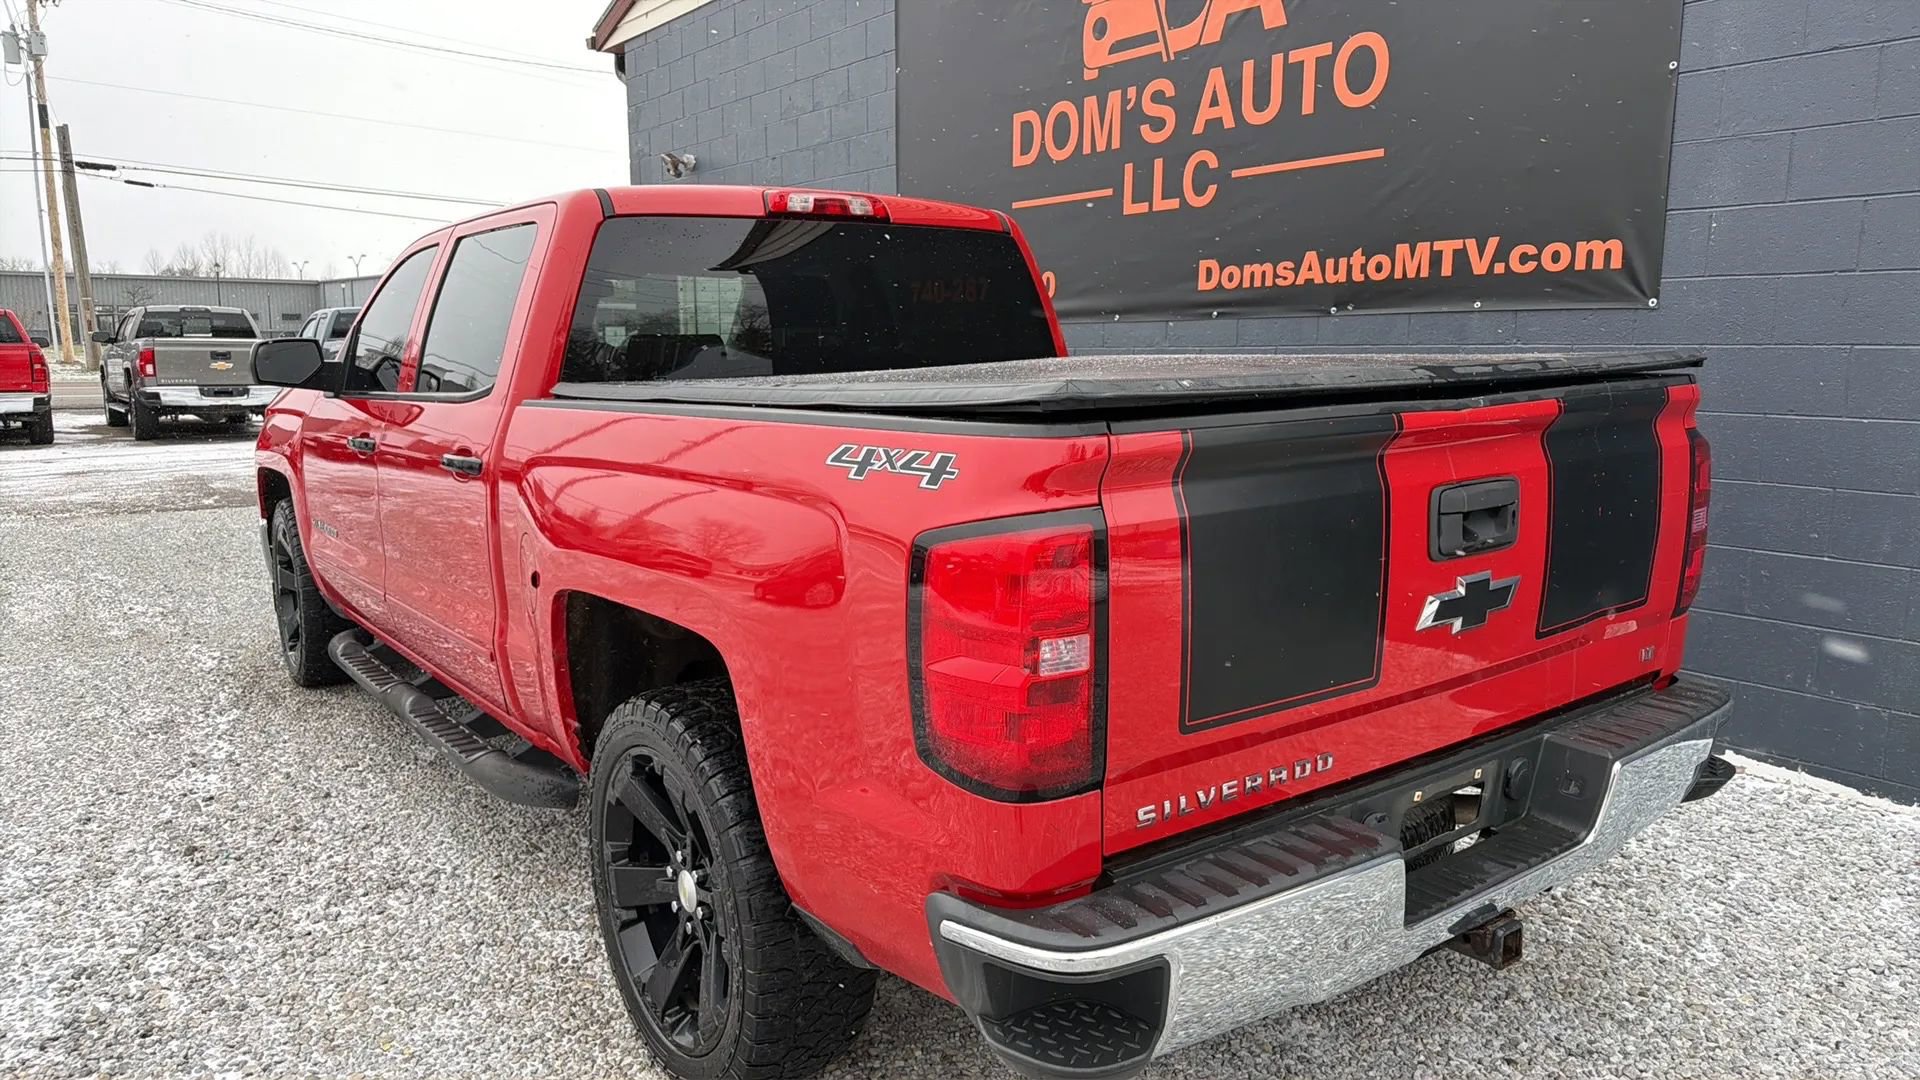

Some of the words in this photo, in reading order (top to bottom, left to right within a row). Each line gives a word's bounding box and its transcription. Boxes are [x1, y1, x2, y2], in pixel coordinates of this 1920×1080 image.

[1012, 78, 1176, 168] DOM'S
[1192, 31, 1390, 135] AUTO
[1123, 150, 1219, 215] LLC
[1197, 236, 1623, 291] DomsAutoMTV.com
[1136, 752, 1334, 829] SILVERADO
